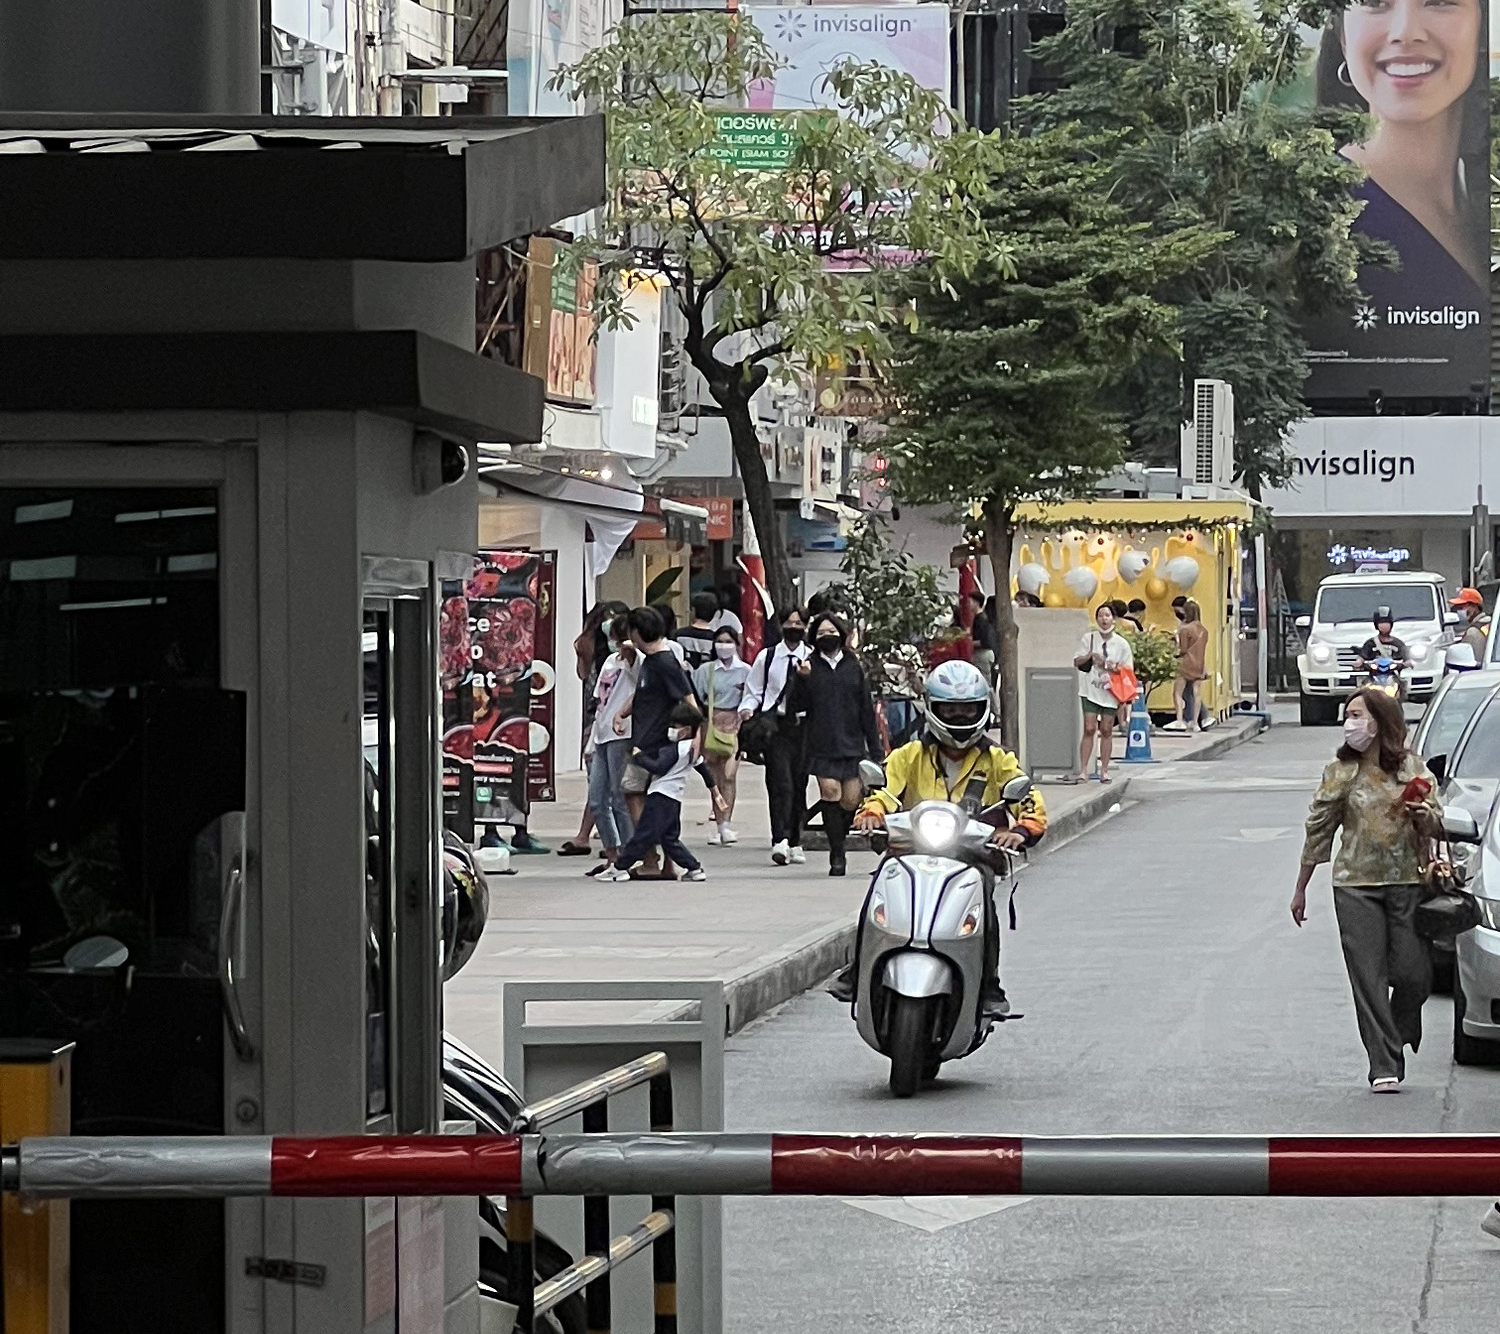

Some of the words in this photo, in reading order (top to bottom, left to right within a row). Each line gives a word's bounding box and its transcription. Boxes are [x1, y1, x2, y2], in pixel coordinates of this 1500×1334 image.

[813, 13, 912, 38] invisalign
[1386, 305, 1480, 330] invisalign
[1290, 449, 1415, 482] nvisalign
